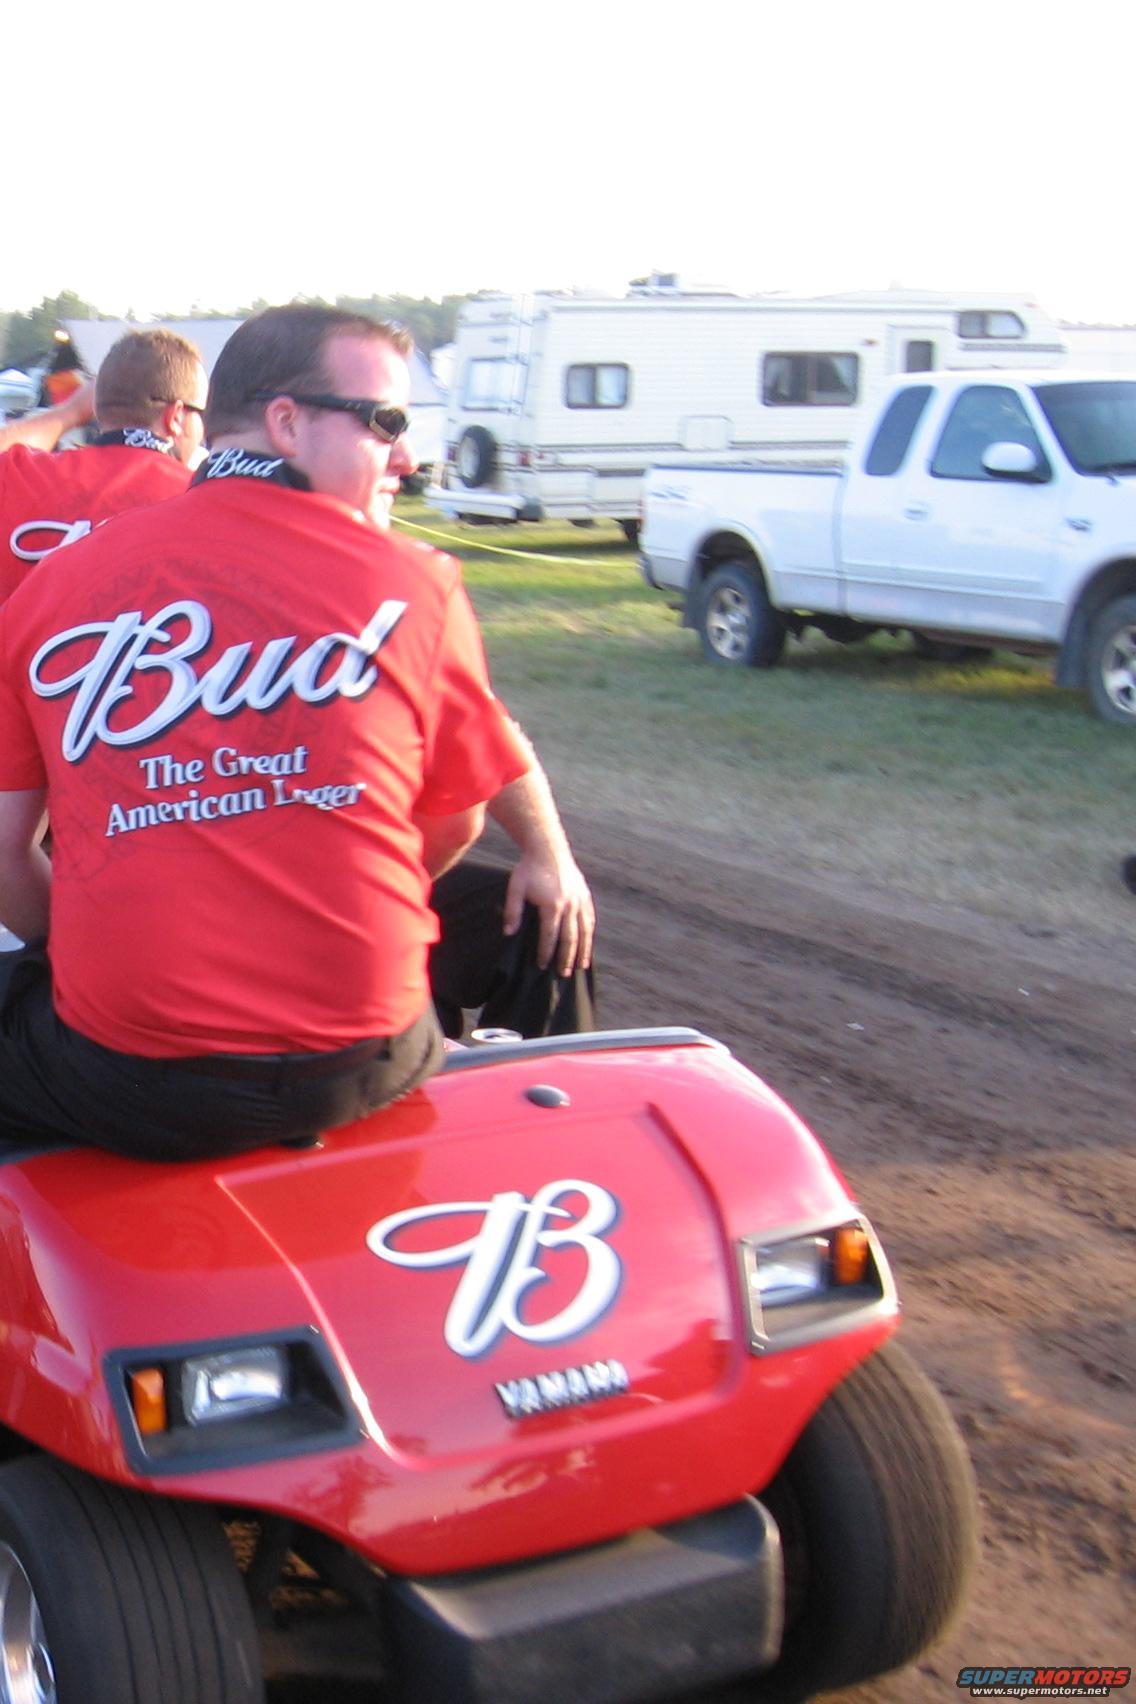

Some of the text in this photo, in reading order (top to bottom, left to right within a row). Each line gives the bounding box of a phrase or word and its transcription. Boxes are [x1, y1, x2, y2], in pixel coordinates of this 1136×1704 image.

[206, 446, 284, 479] Bud
[28, 599, 409, 763] Bud
[138, 744, 309, 790] The Great
[104, 786, 268, 838] American
[366, 1179, 624, 1362] B
[494, 1358, 630, 1419] YAMAHA
